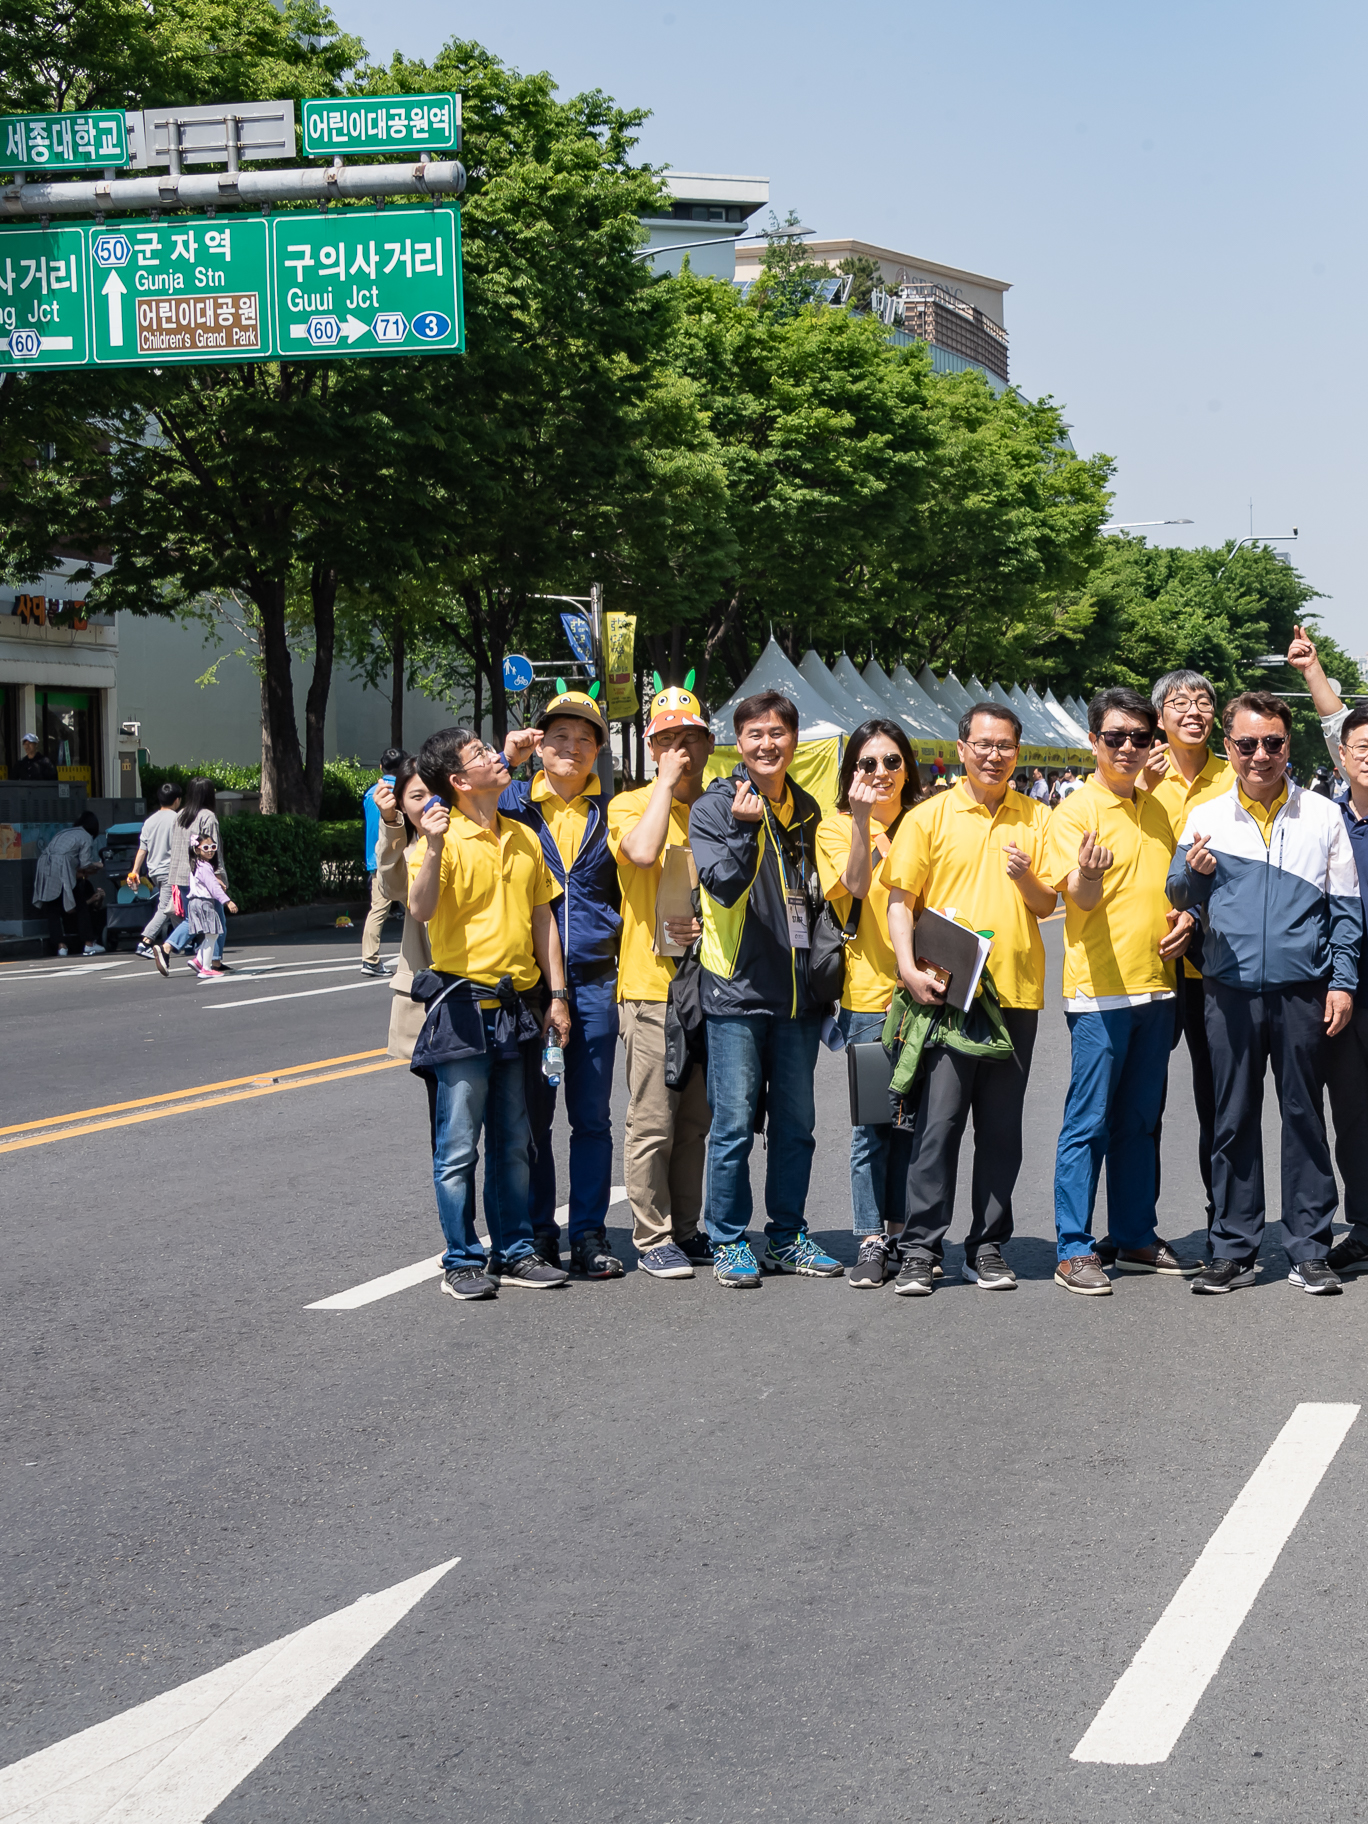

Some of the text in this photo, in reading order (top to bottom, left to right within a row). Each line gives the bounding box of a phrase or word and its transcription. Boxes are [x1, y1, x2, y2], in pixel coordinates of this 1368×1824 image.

[309, 104, 450, 142] 어린이대공원역
[6, 118, 121, 163] 세종대학교
[100, 240, 124, 262] 50
[284, 237, 443, 282] 구의사거리
[135, 267, 225, 294] Gunja Stn
[287, 285, 379, 312] Guui Jct
[28, 299, 60, 322] Jct
[139, 297, 256, 329] 어린이대공원
[314, 321, 333, 340] 60
[380, 318, 400, 337] 71
[424, 315, 438, 336] 3
[14, 333, 34, 352] 60
[141, 327, 256, 349] Children's Grand Park
